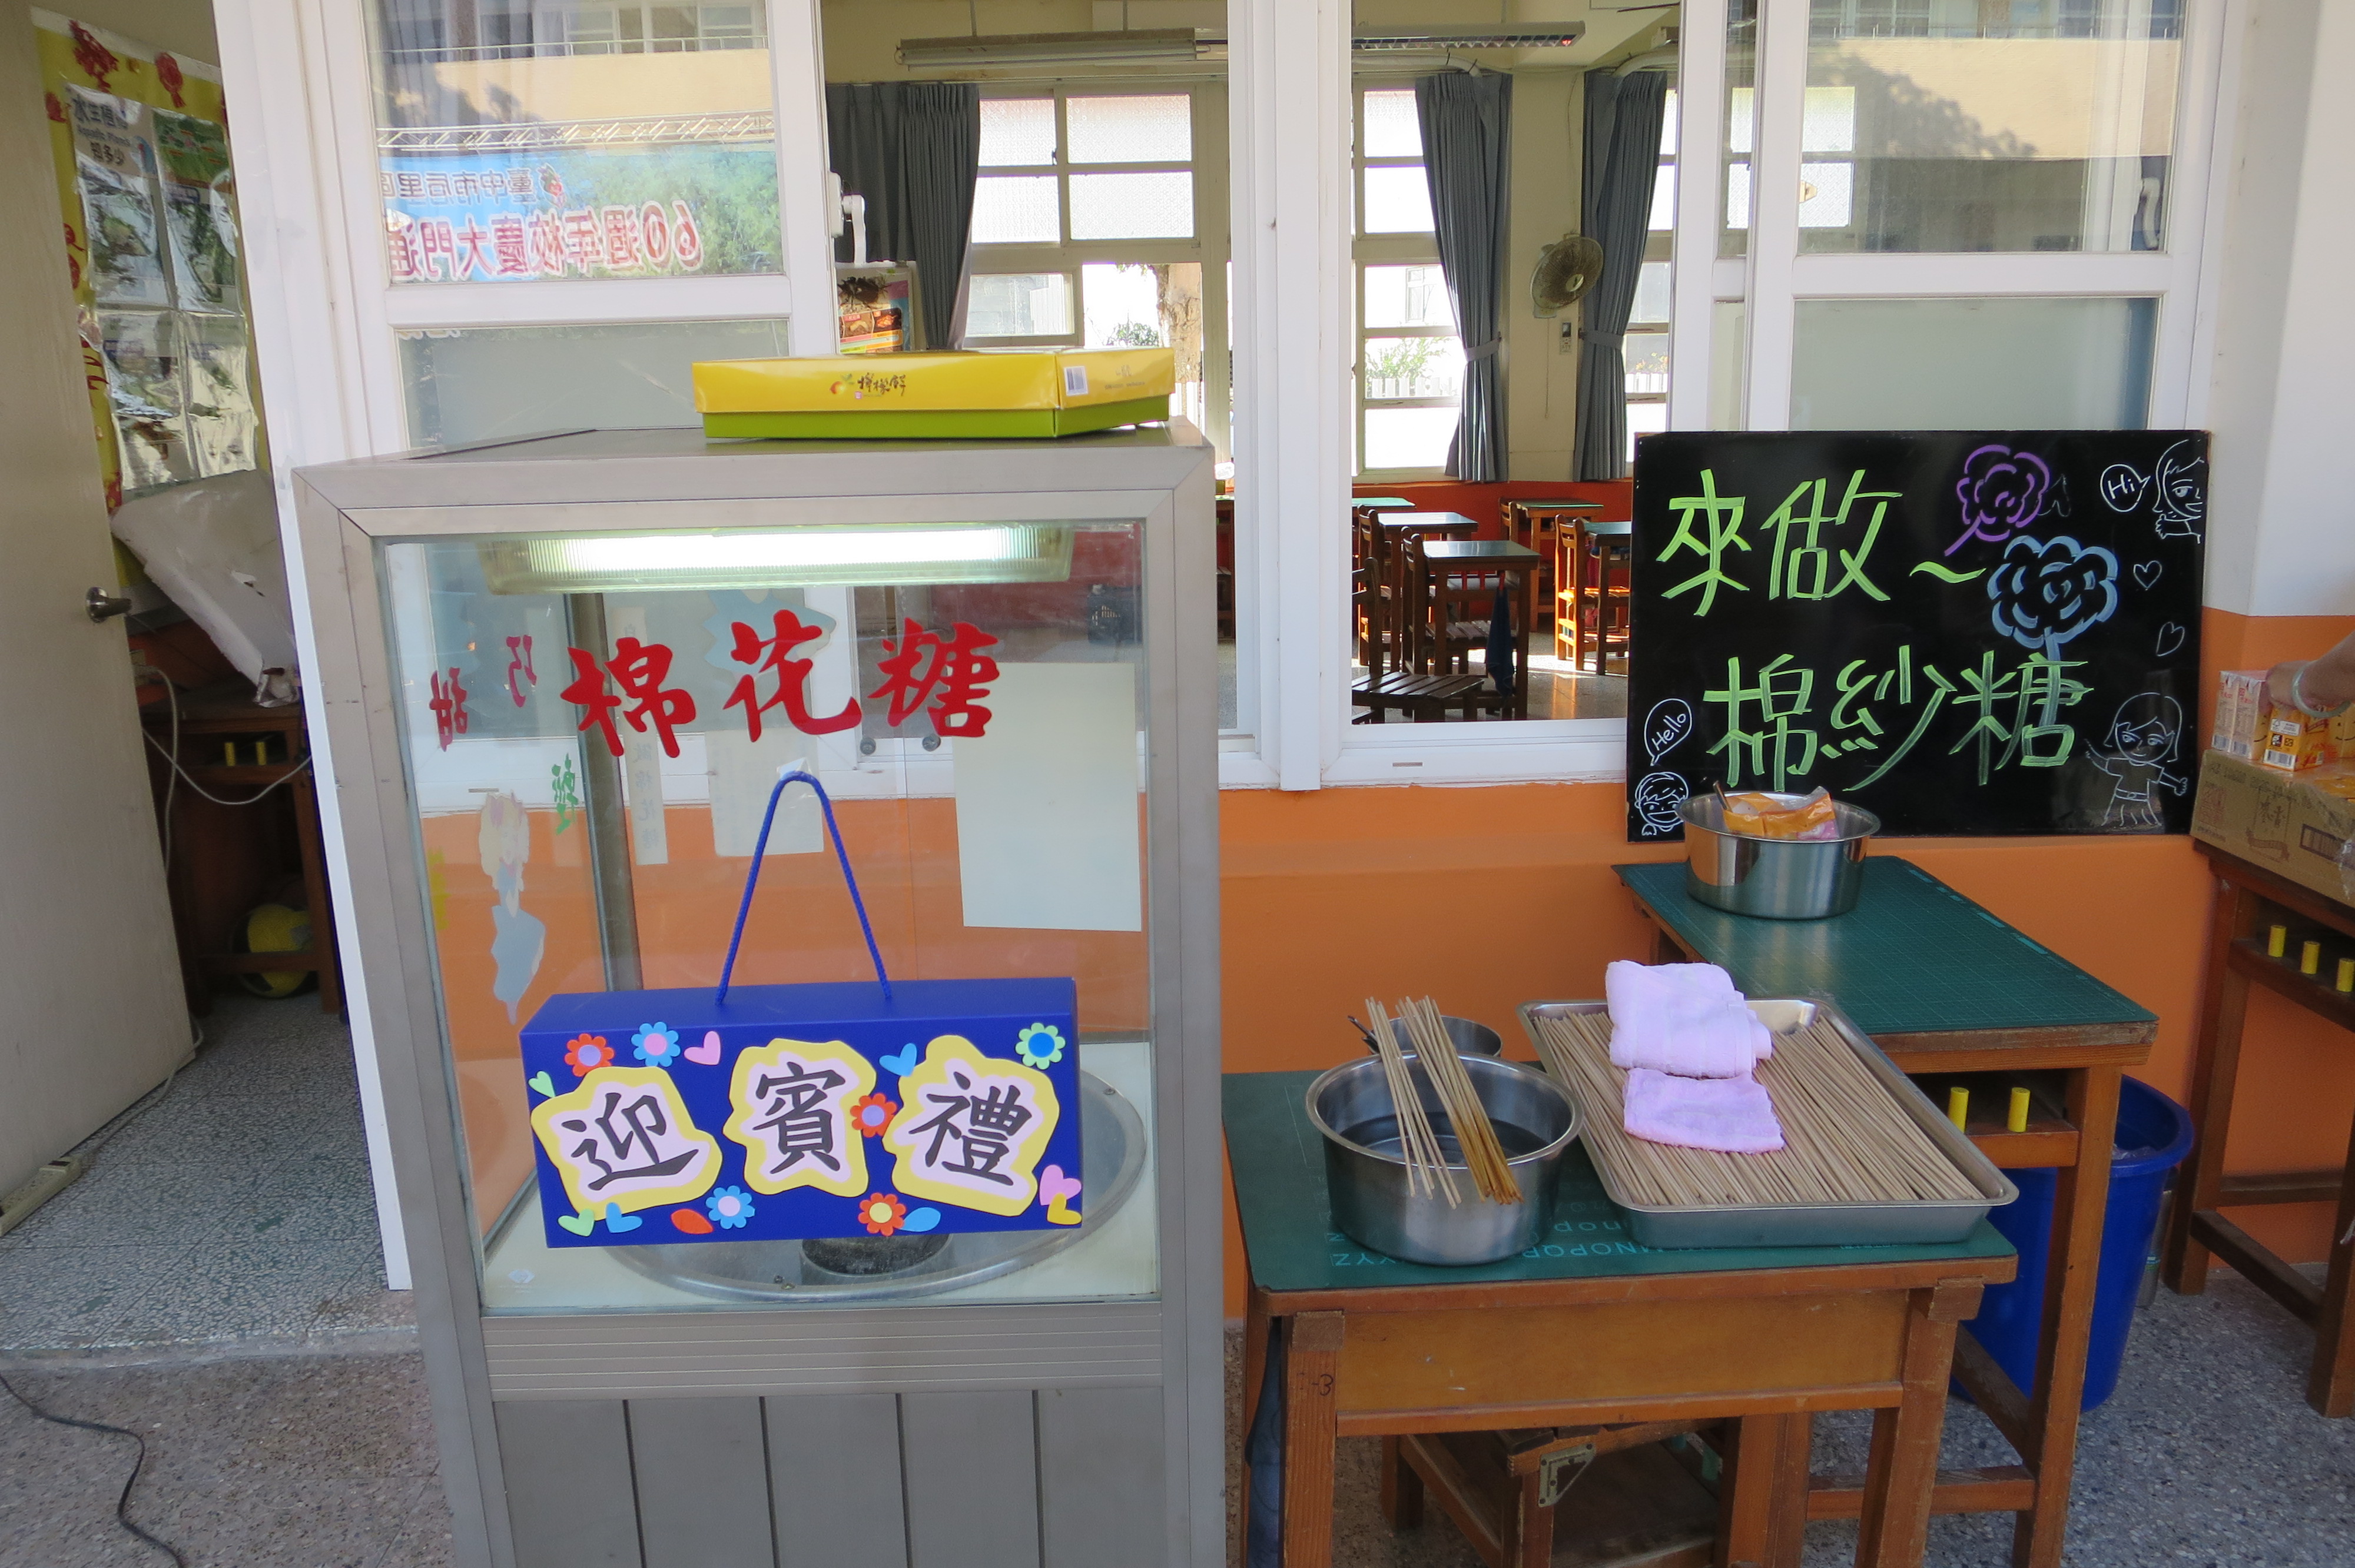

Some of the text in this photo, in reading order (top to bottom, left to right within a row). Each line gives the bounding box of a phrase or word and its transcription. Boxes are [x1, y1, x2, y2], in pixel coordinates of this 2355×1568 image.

[2108, 474, 2135, 500] Hi
[560, 609, 1000, 759] 棉花糖
[1651, 713, 1687, 751] Hello
[1704, 645, 2095, 792] 棉紗糖
[561, 1061, 1033, 1191] 迎賓禮
